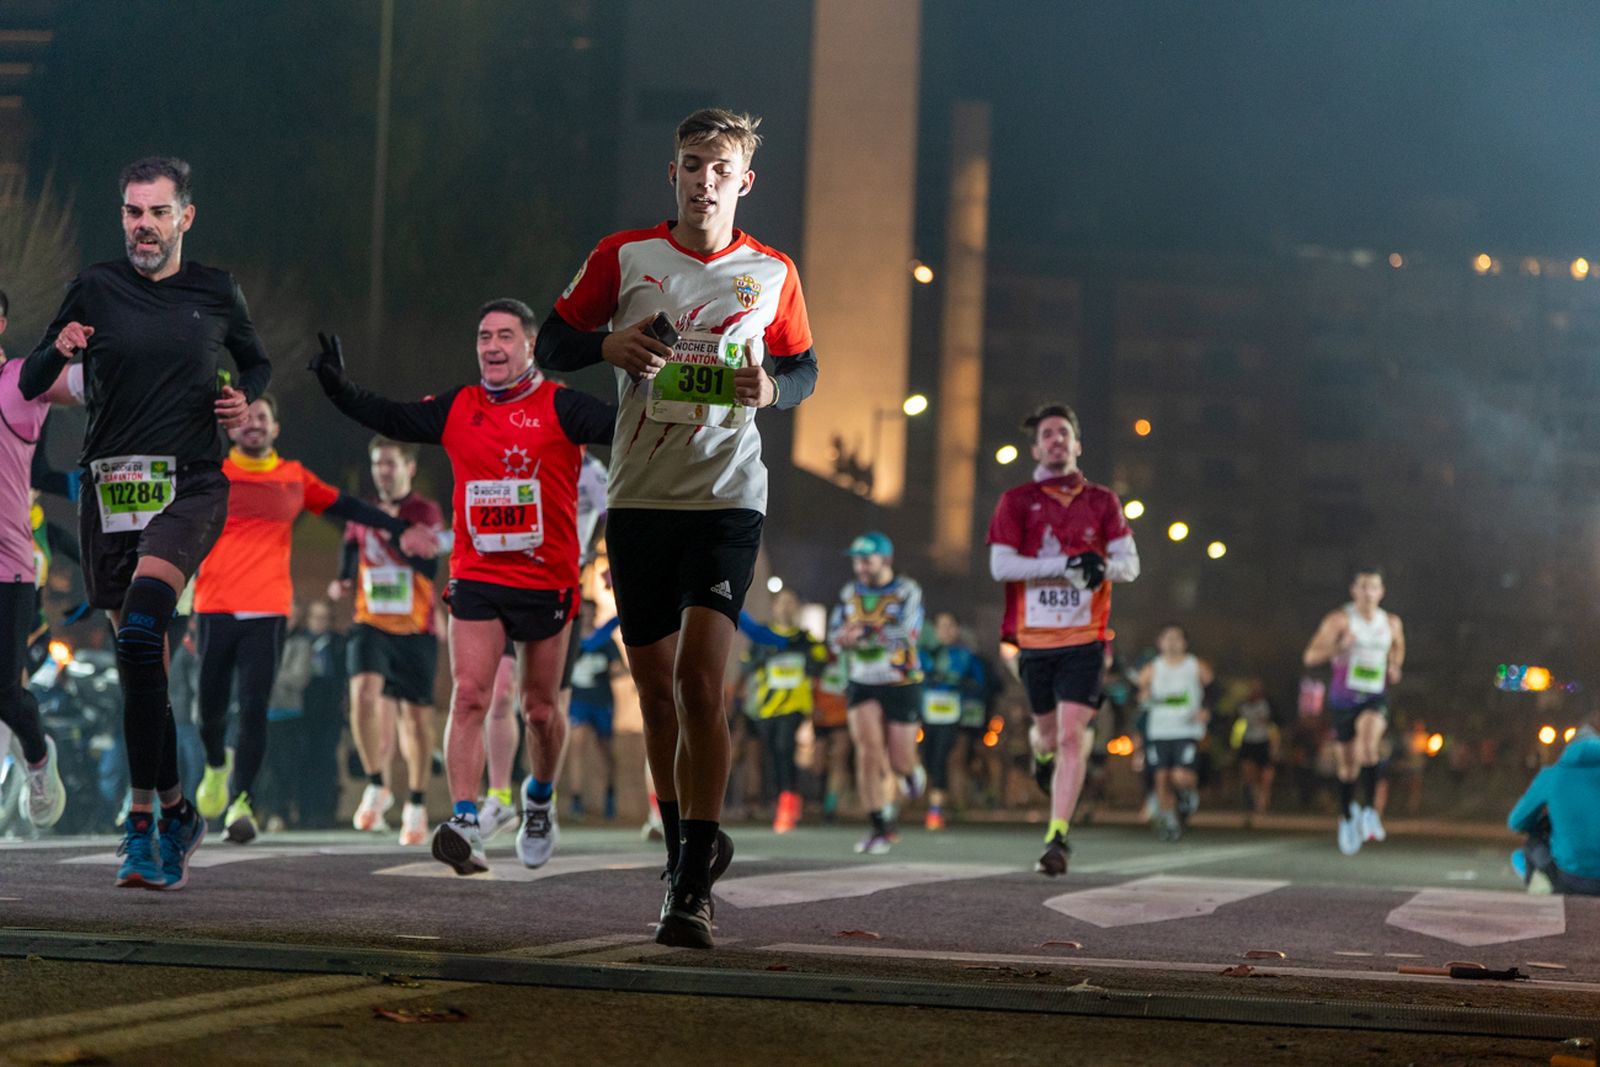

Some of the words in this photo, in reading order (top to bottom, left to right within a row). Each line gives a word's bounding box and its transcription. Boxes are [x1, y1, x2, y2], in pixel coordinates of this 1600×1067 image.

[675, 342, 705, 352] NOCHE
[707, 344, 719, 354] DE
[684, 352, 717, 365] ANTÓN
[678, 365, 724, 395] 391
[108, 482, 164, 505] 12284
[480, 505, 525, 527] 2387
[1039, 590, 1080, 606] 4839
